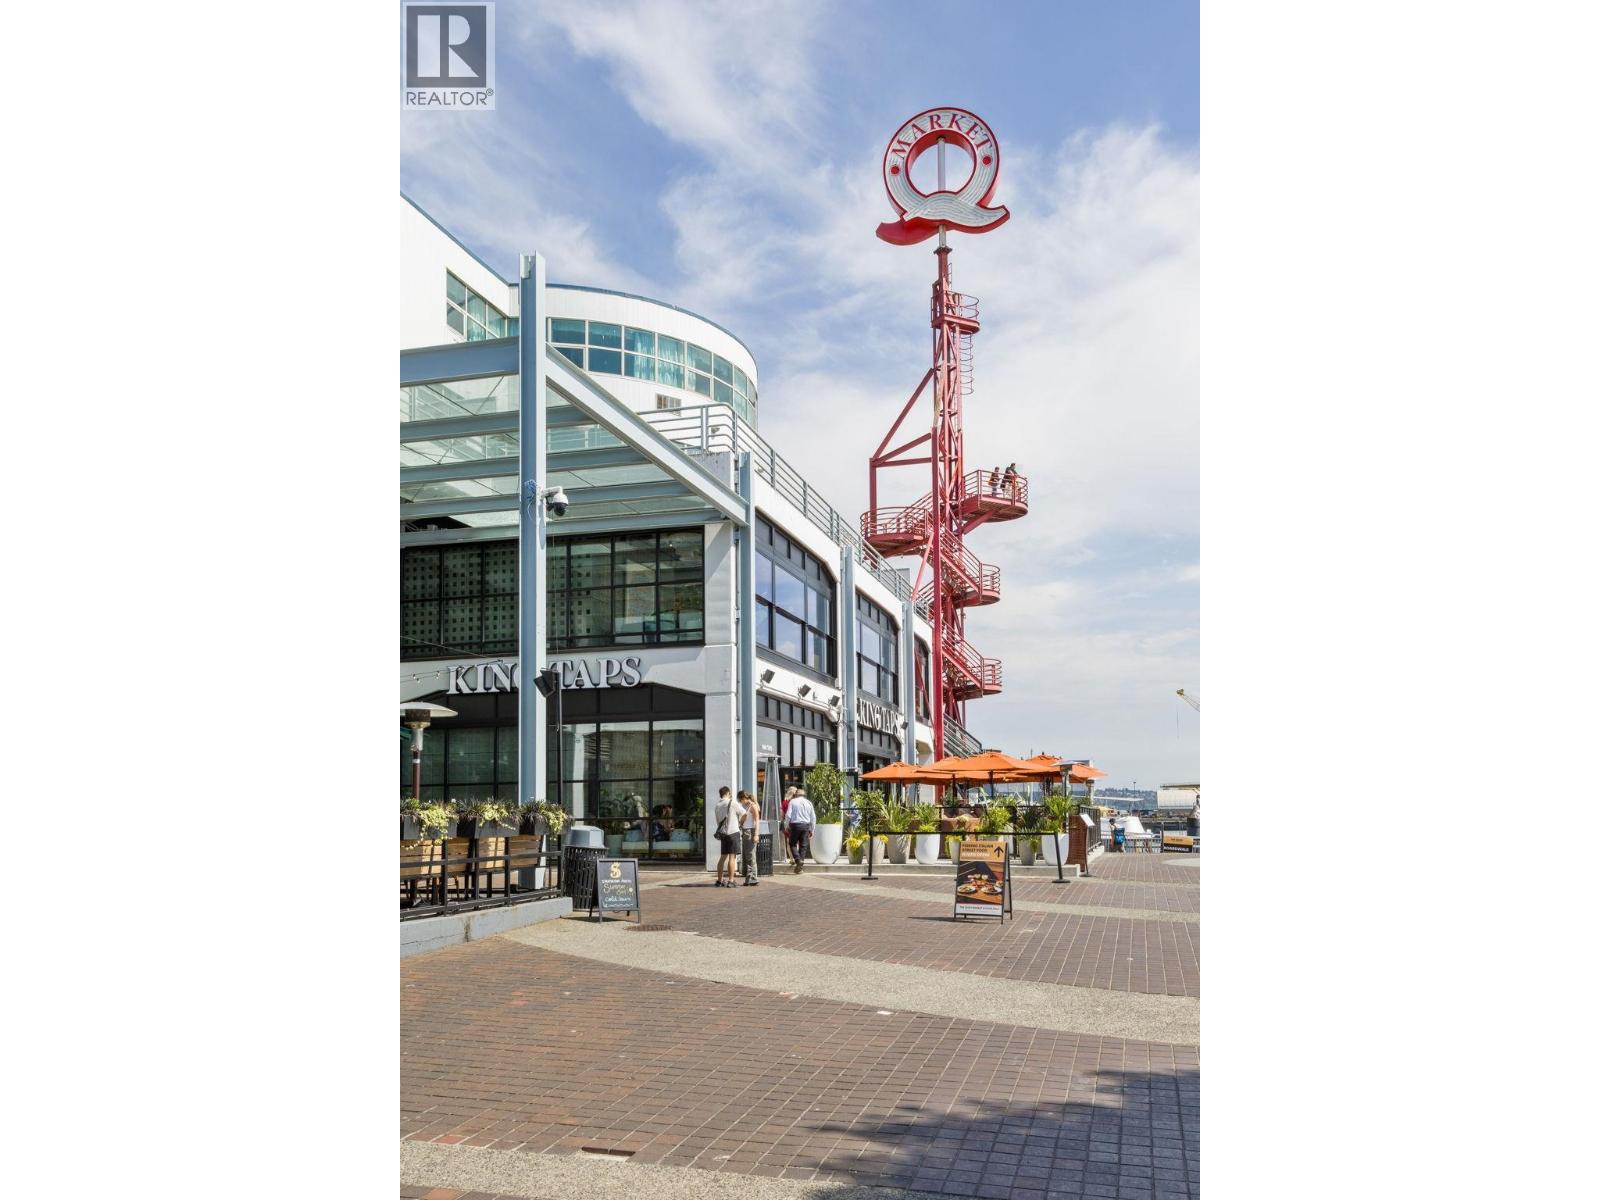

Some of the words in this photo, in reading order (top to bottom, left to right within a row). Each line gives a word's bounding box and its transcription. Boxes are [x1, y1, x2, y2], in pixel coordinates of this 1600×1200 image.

[891, 112, 993, 160] MARKET
[446, 661, 520, 694] KIN
[550, 656, 642, 690] TAPS
[860, 698, 881, 731] KING
[881, 707, 899, 737] TAPS
